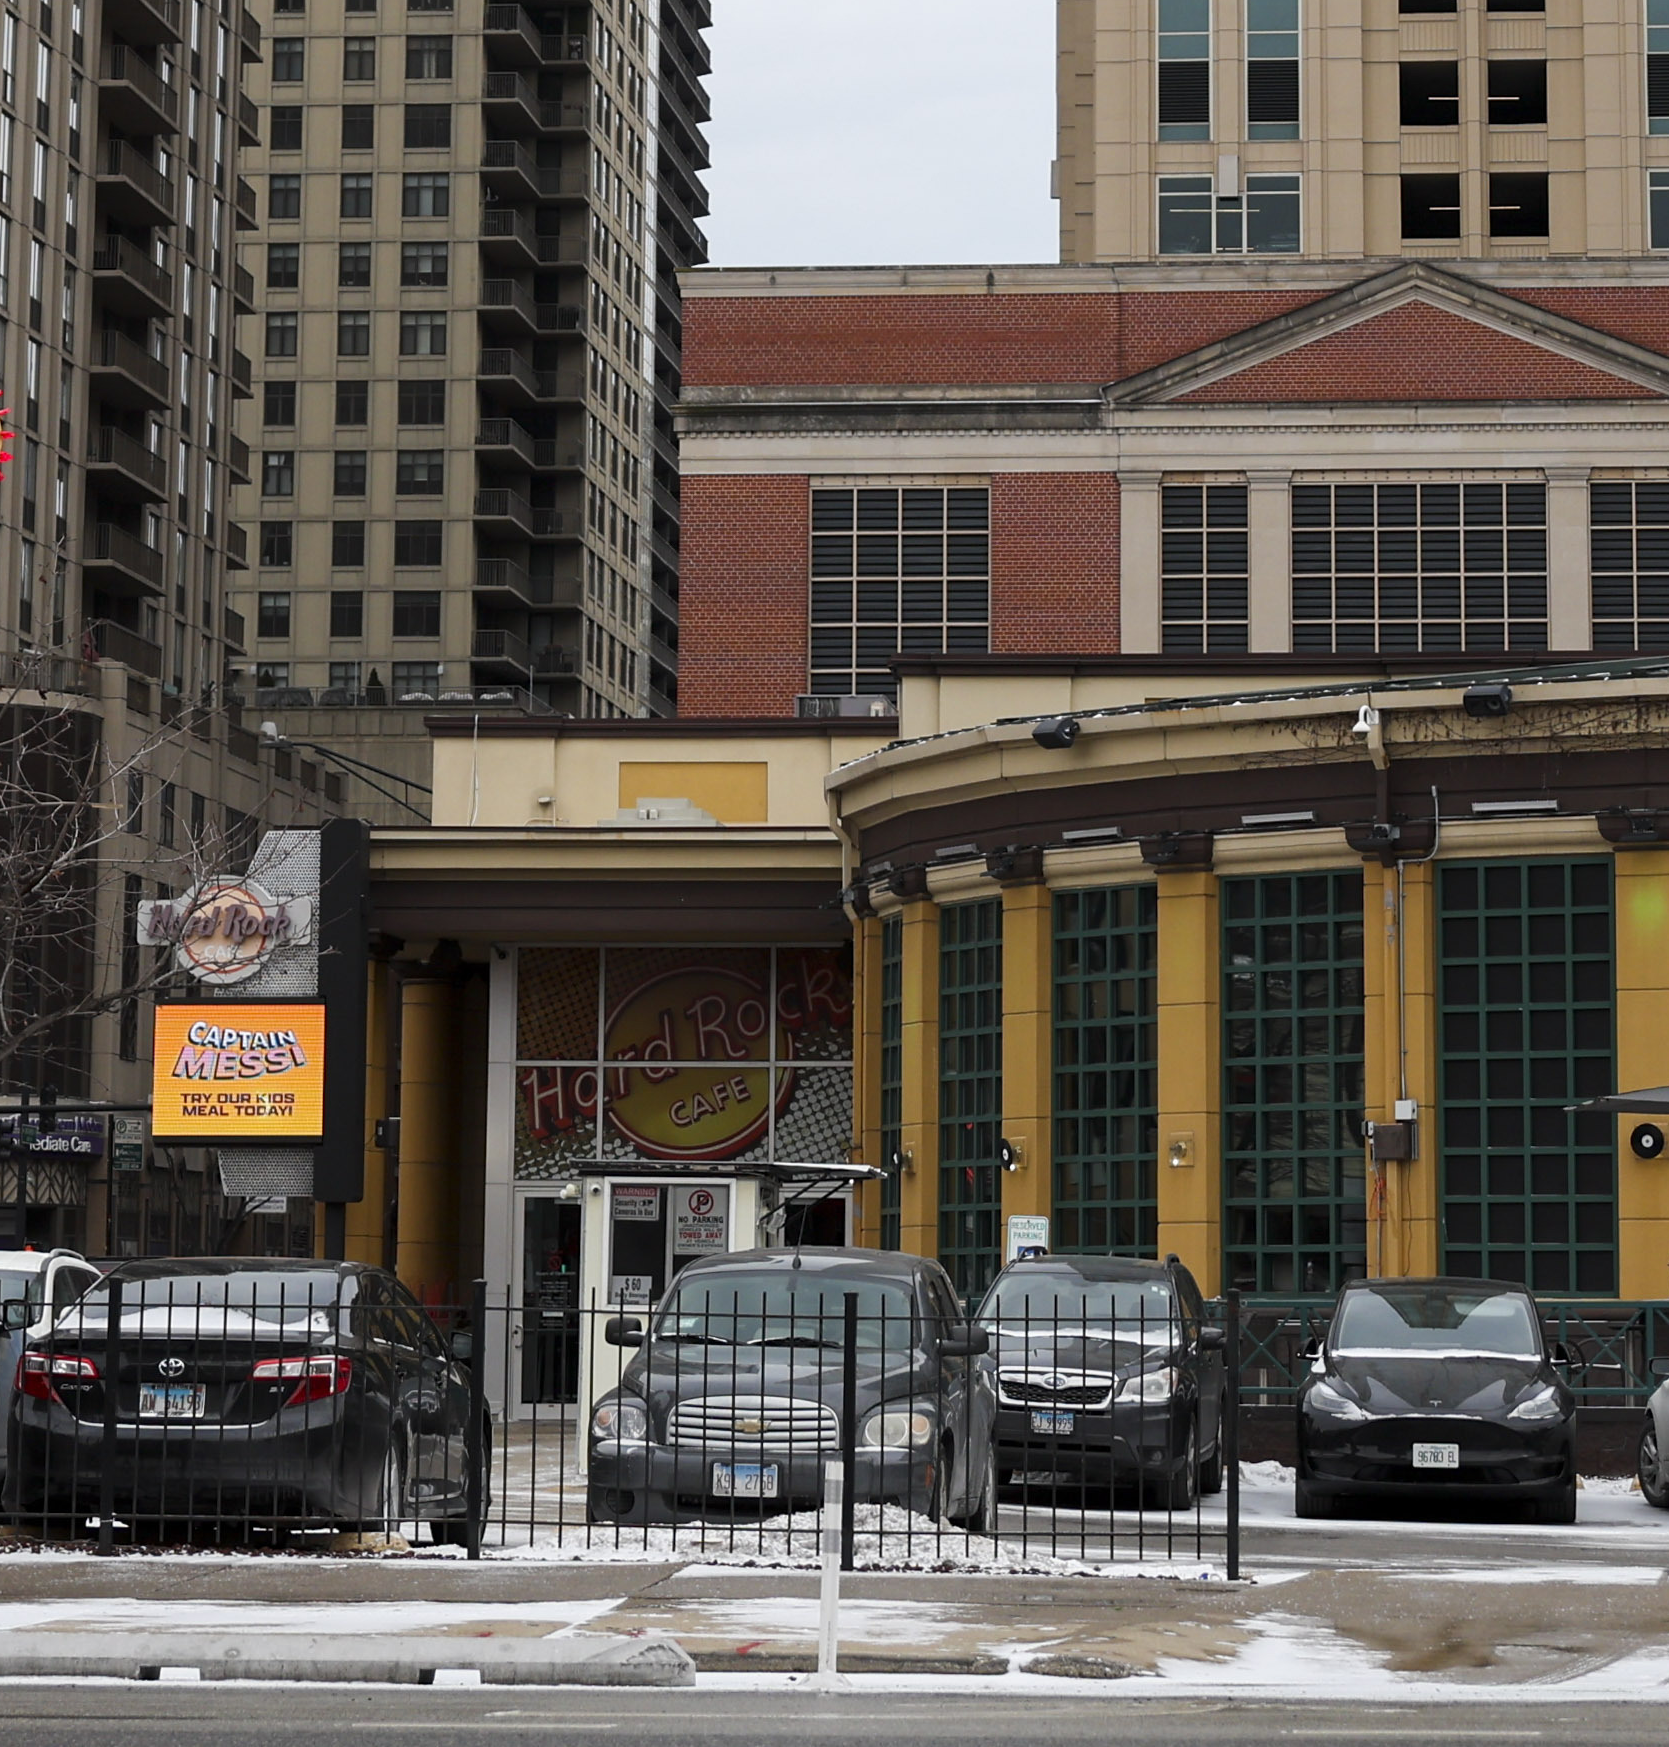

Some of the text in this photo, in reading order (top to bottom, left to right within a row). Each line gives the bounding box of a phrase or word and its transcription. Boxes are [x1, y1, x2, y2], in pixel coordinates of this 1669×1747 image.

[146, 903, 291, 943] Hard Rock
[188, 1021, 297, 1050] CAPTAIN
[522, 956, 853, 1138] Hard Rock
[172, 1046, 307, 1080] MESSI
[181, 1093, 295, 1104] TRY OUR KIDS
[669, 1074, 751, 1126] CAFE
[182, 1105, 293, 1116] MEAL TODAY!
[13, 1136, 91, 1152] ediate Care
[615, 1187, 656, 1196] WARNING
[615, 1198, 637, 1207] Security
[1011, 1221, 1045, 1231] RESERVED
[1013, 1232, 1043, 1240] PARKING
[1046, 1417, 1073, 1430] 9995
